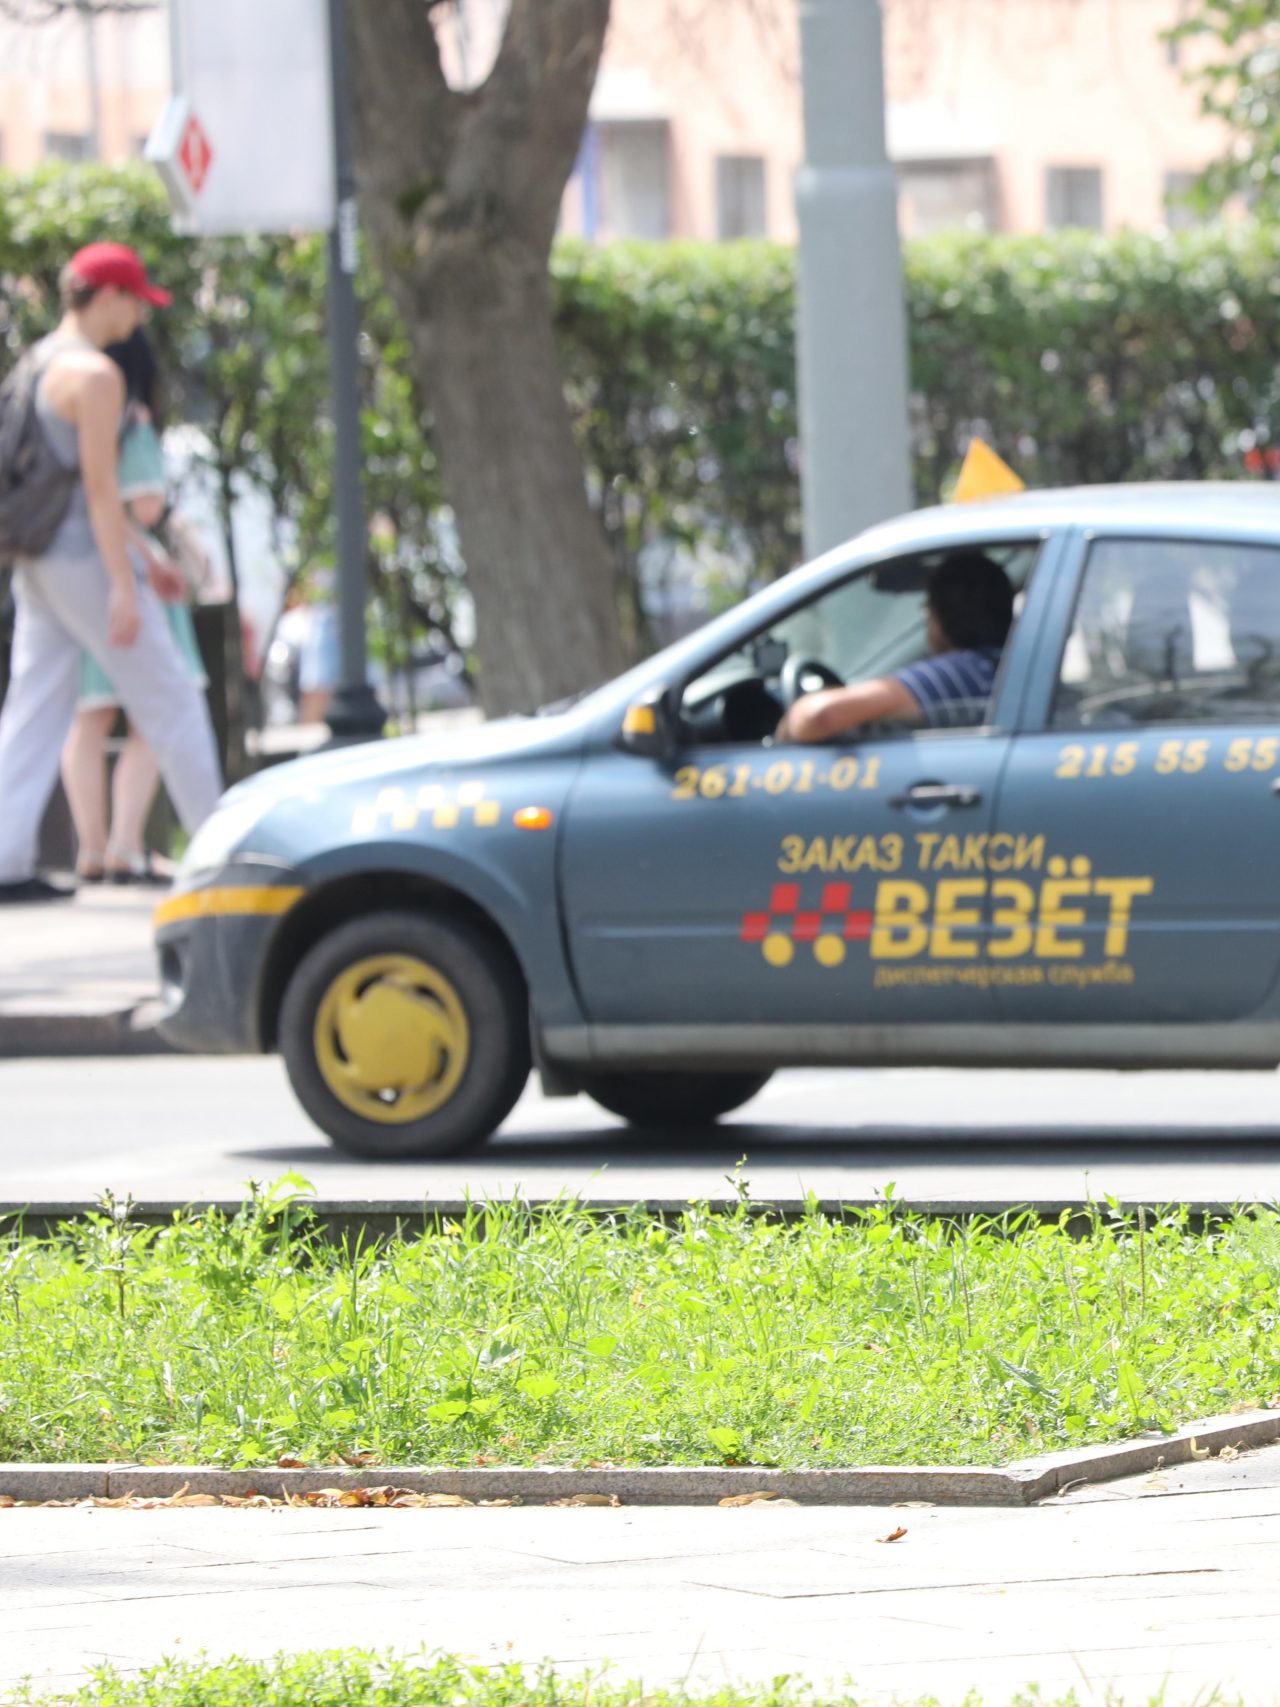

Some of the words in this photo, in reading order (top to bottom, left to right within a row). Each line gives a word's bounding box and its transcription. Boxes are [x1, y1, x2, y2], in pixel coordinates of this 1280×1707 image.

[671, 756, 880, 800] 261-01-01
[1055, 741, 1139, 779] 215
[1154, 738, 1209, 774] 55
[1223, 736, 1280, 772] 55
[777, 835, 903, 873] ЗАКАЗ
[914, 832, 1046, 872] ТАКСИ
[869, 855, 1155, 959] ВЕЗЁТ
[1048, 962, 1135, 988] служба
